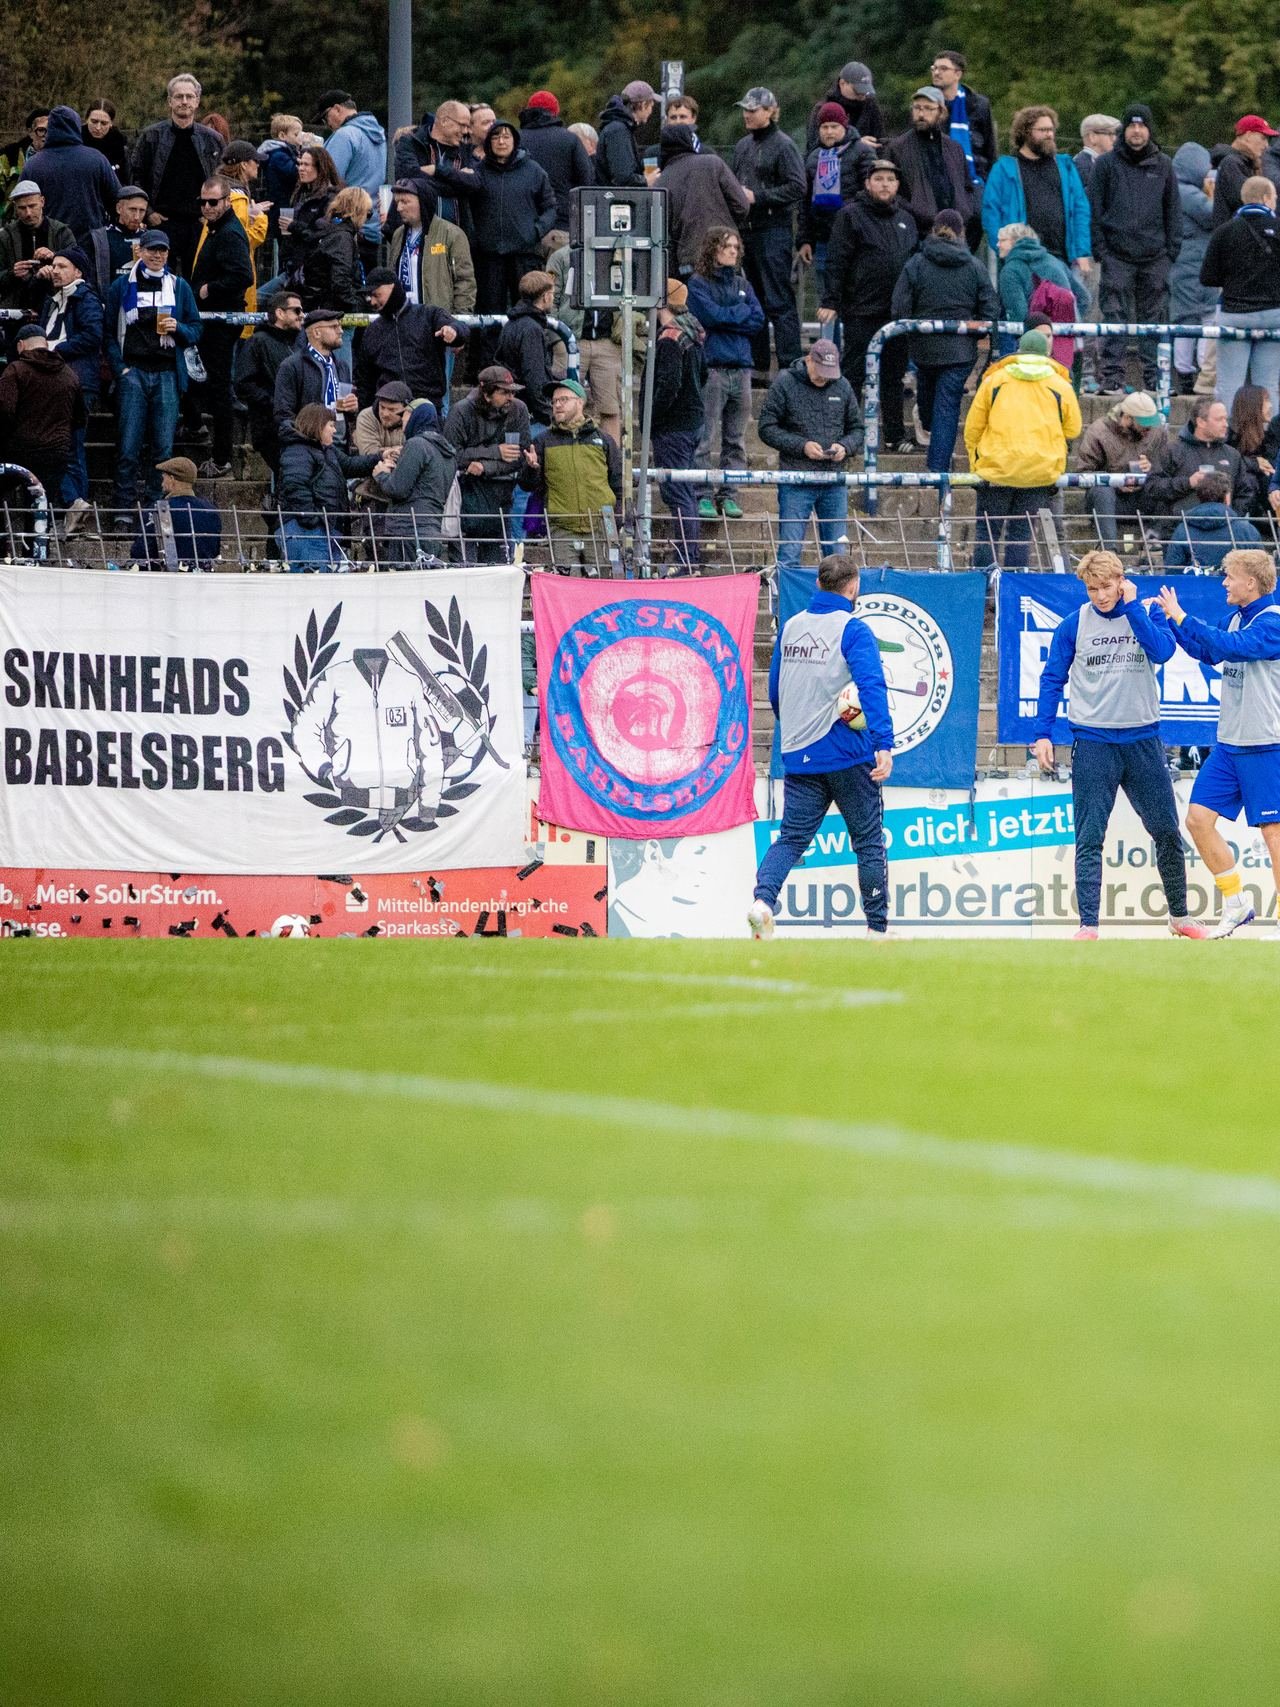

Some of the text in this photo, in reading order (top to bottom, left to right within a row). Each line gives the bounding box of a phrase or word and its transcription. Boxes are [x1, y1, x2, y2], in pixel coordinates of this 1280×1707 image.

[560, 608, 624, 684] GAY
[852, 600, 943, 660] oppola
[4, 648, 250, 716] SKINHEADS
[4, 728, 285, 793] BABELSBERG
[904, 812, 978, 847] dich
[988, 803, 1075, 847] jetzt!
[377, 898, 569, 917] Mittelbrandenburgische
[377, 920, 458, 936] Sparkasse
